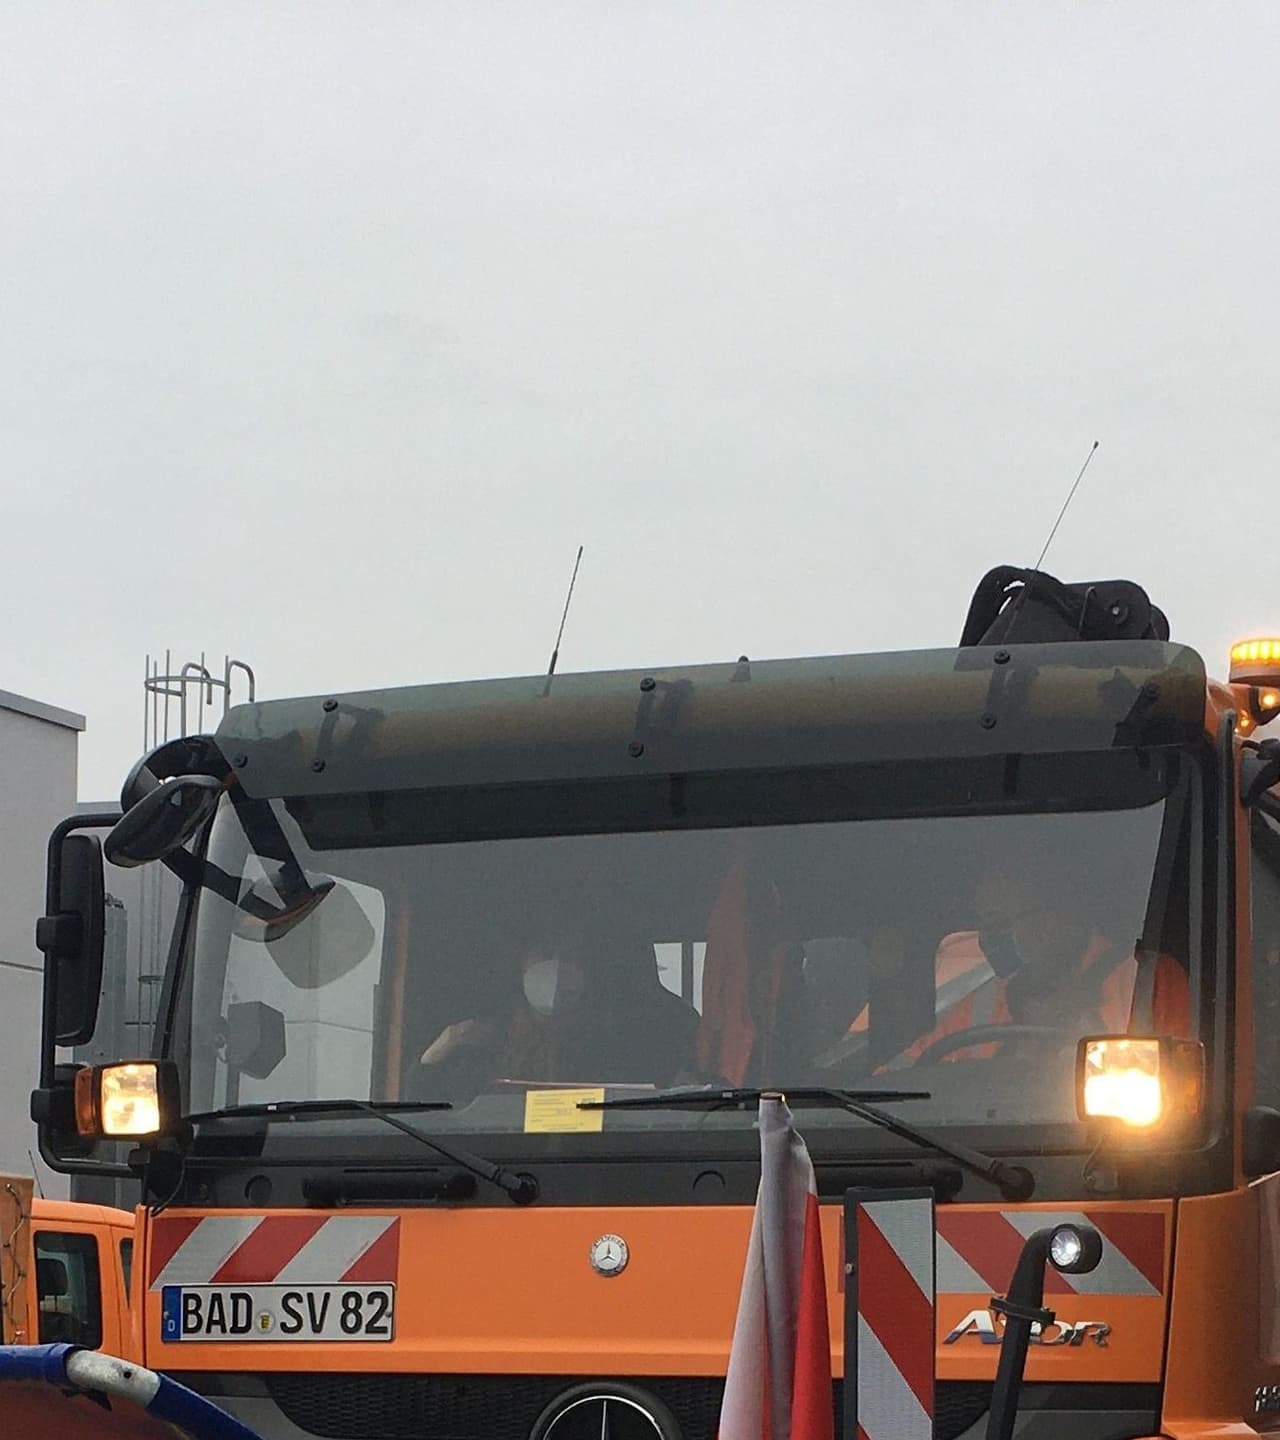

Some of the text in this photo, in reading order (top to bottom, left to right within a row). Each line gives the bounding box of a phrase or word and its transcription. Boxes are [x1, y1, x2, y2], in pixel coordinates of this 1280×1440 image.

[182, 1292, 253, 1334] BAD
[279, 1291, 331, 1334] SV
[340, 1291, 389, 1334] 82
